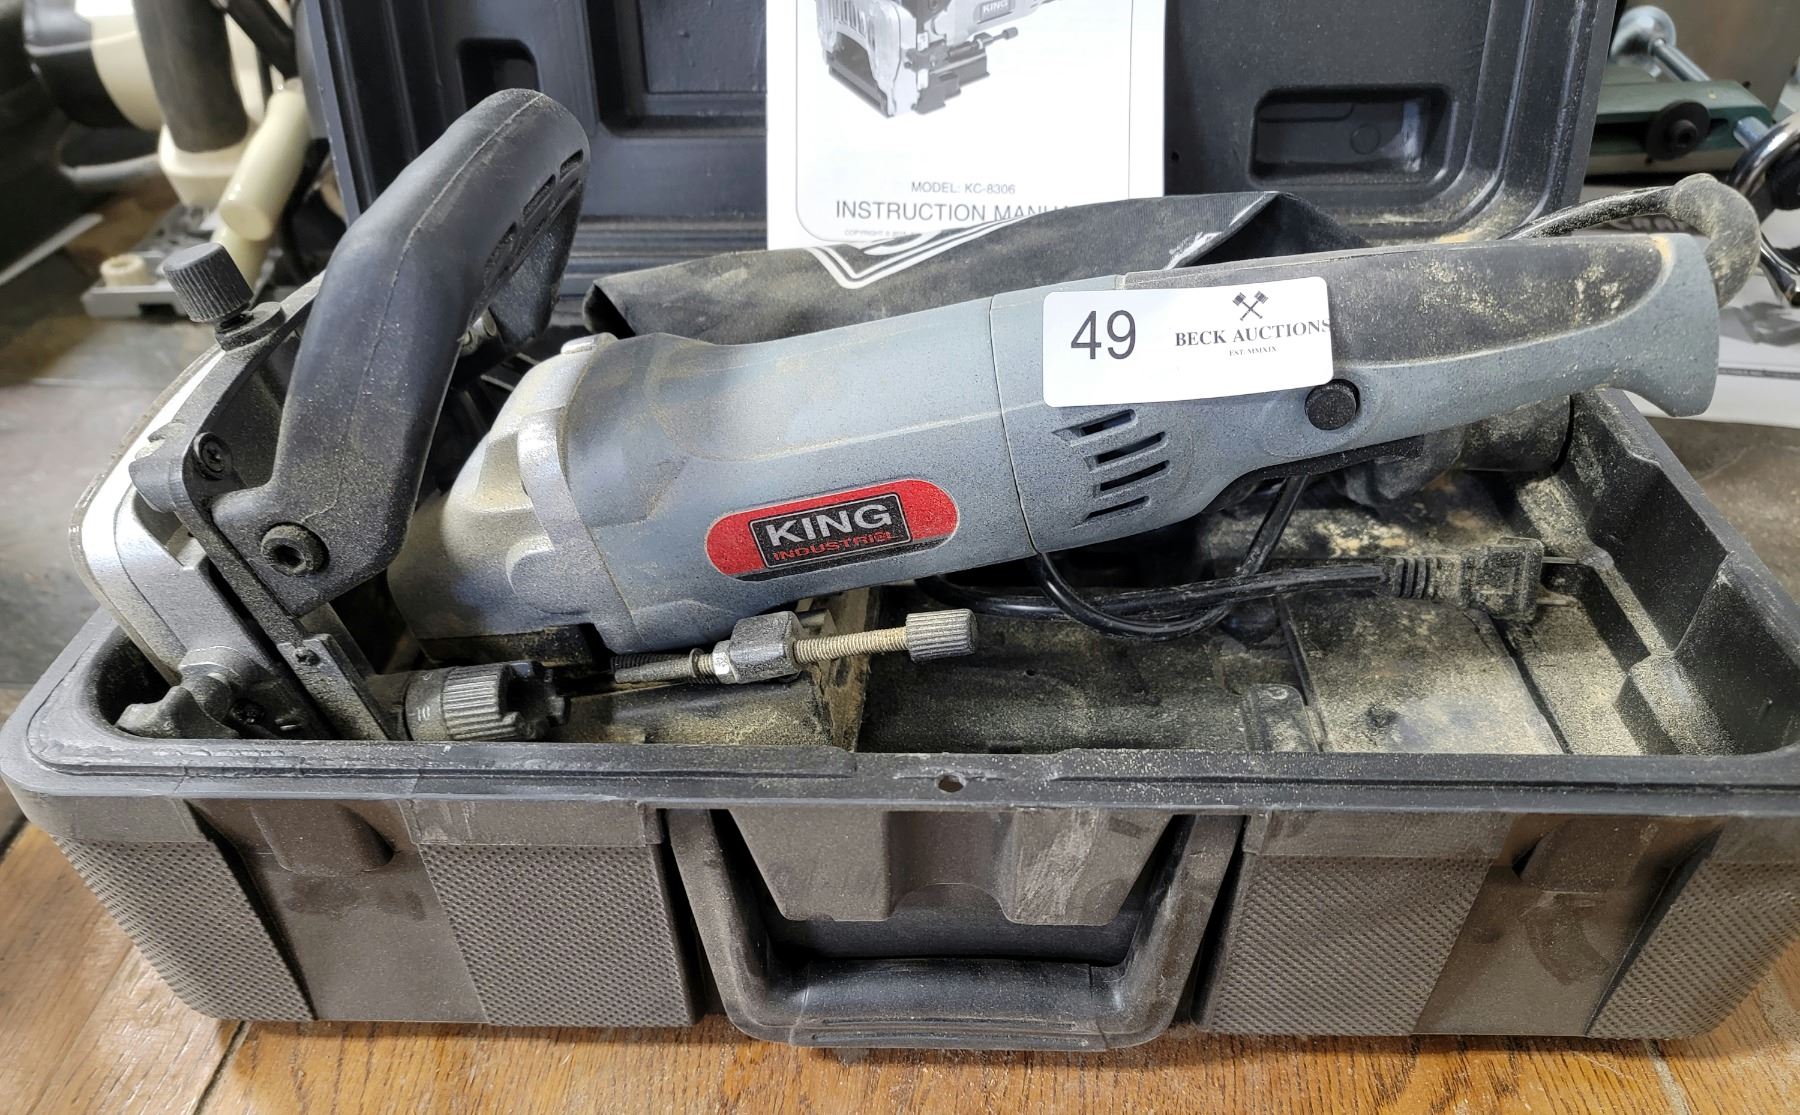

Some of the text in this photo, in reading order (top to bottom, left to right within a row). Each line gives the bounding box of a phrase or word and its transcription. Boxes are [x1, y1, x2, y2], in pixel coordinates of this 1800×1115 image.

[911, 181, 1016, 194] MODEL: KC-8306
[836, 200, 986, 221] INSTRUCTION
[1070, 310, 1136, 360] 49
[1175, 329, 1227, 346] BECK
[766, 504, 893, 547] KING
